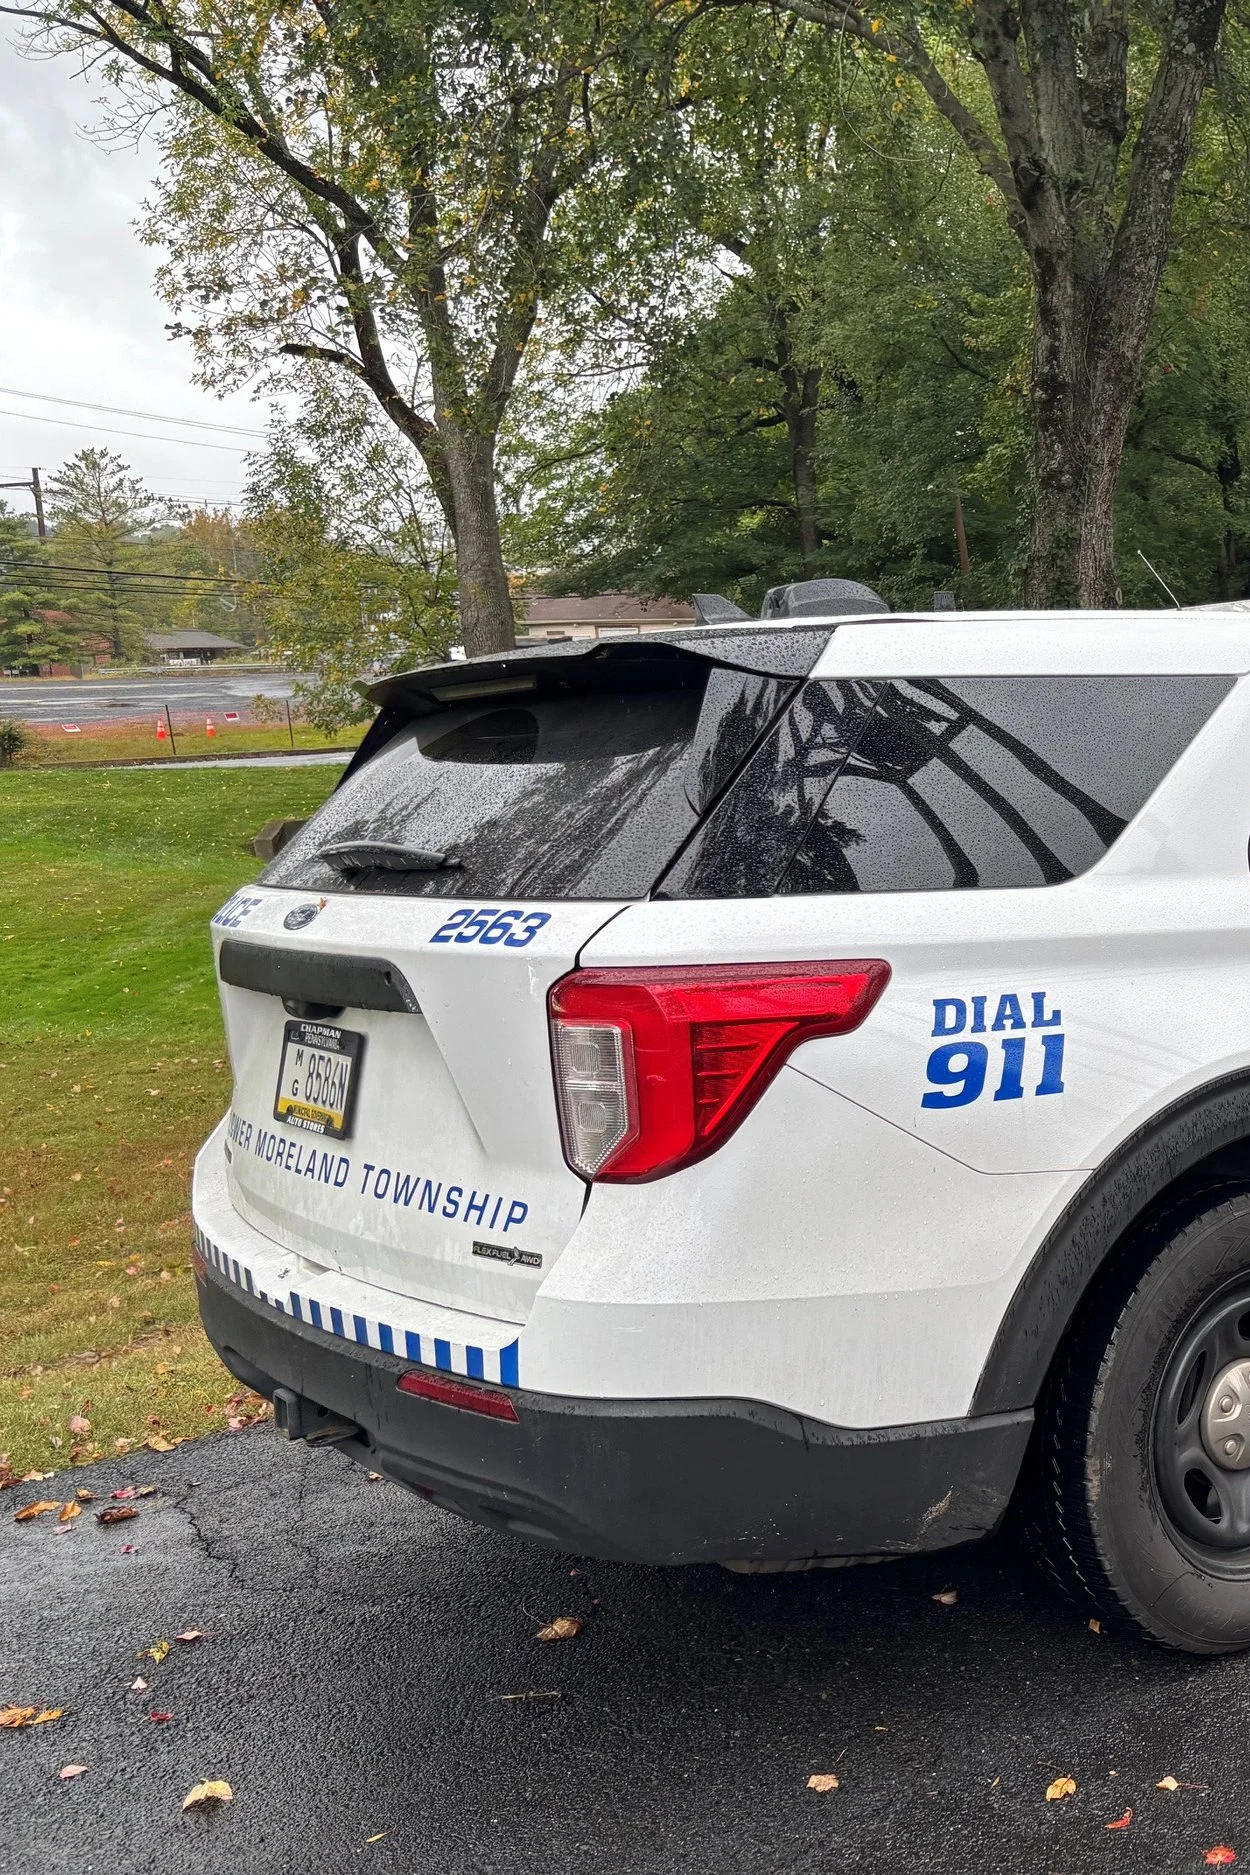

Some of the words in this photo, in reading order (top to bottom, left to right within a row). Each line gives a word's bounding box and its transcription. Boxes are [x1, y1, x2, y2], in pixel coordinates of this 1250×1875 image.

[428, 908, 552, 948] 2563
[301, 1023, 342, 1039] CHAPMAN
[931, 991, 1062, 1037] DIAL
[291, 1078, 299, 1097] G
[295, 1048, 304, 1067] M
[305, 1052, 349, 1109] 8586N
[921, 1033, 1065, 1110] 911
[286, 1115, 302, 1128] AUTO
[302, 1120, 326, 1134] STORES
[254, 1128, 350, 1188] MORELAND
[360, 1163, 529, 1233] TOWNSHIP
[520, 1254, 541, 1265] AWD
